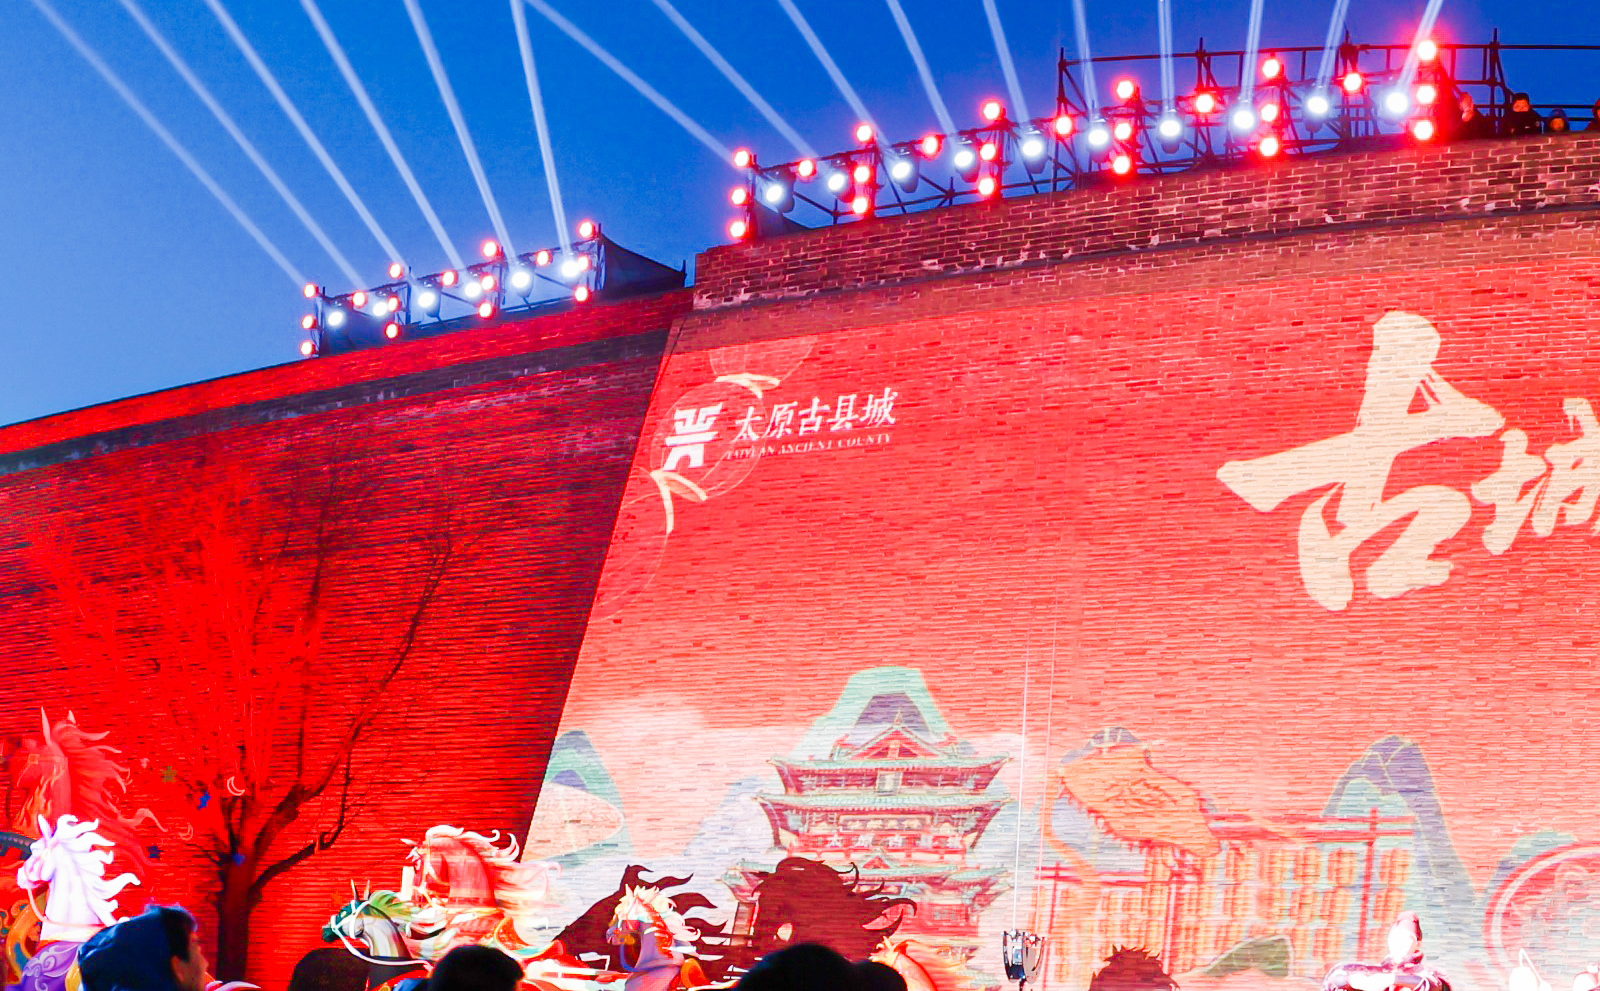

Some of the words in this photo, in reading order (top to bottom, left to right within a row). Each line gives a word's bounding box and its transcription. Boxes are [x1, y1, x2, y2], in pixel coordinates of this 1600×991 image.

[730, 387, 899, 443] 太原古县城
[779, 439, 833, 455] ANCIENT
[838, 433, 892, 448] COUNTY
